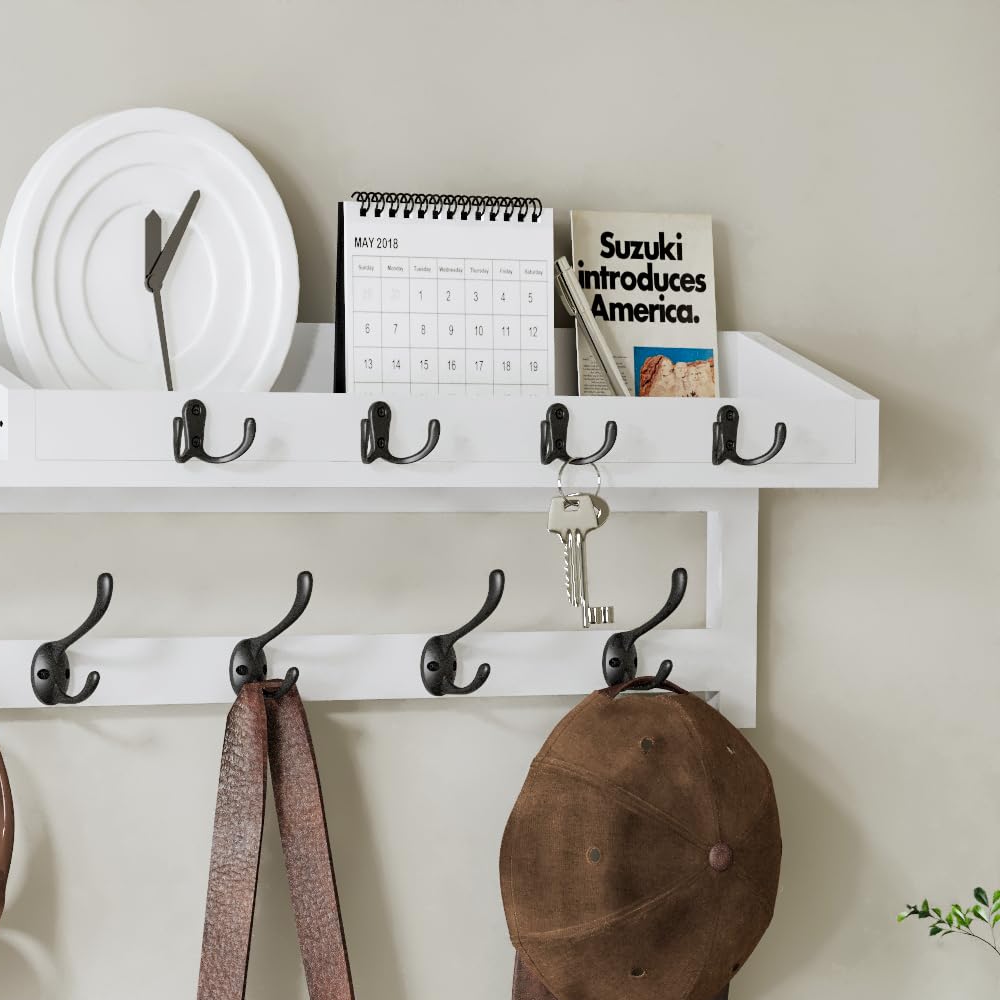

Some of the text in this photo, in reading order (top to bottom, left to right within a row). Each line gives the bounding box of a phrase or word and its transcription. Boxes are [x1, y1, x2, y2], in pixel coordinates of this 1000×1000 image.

[354, 237, 398, 249] MAY 2018
[600, 232, 682, 260] Suzuki
[578, 260, 707, 292] introduces
[591, 293, 700, 324] America.
[365, 323, 538, 338] 6 7 8 9 10 11 12
[364, 359, 538, 372] 13 14 15 16 17 18 19
